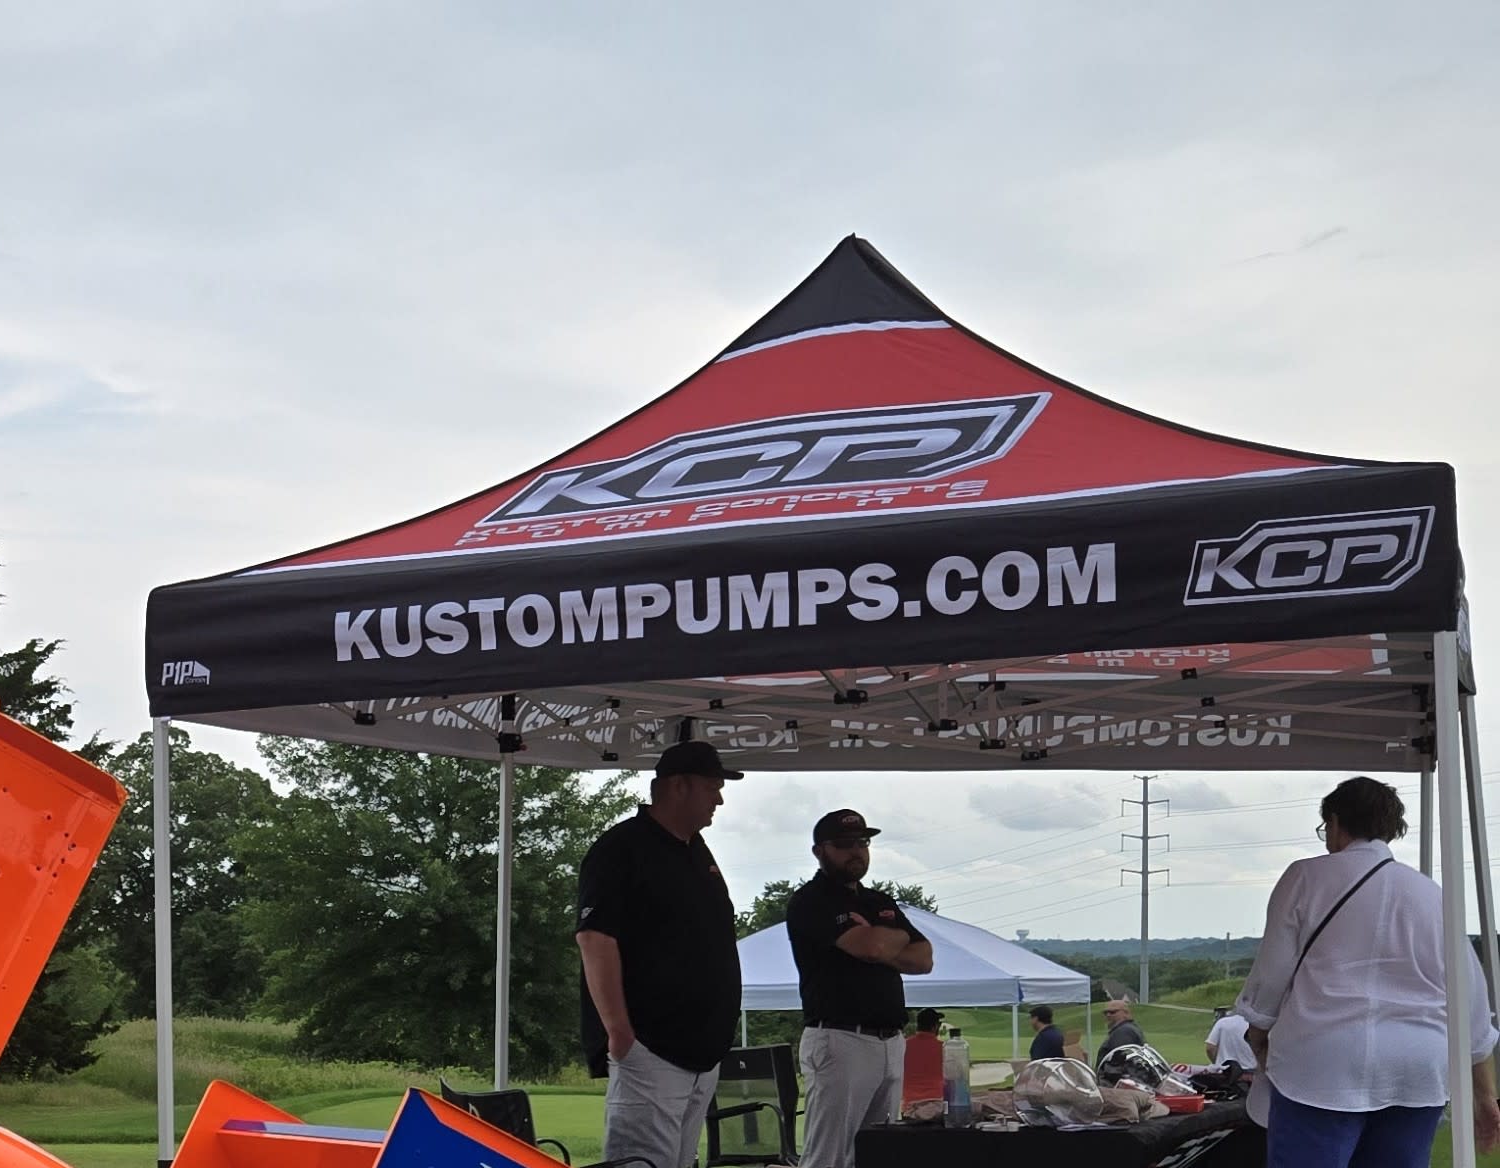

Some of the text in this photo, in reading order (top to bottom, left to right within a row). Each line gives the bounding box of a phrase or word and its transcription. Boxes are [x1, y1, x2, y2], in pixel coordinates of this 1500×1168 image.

[503, 405, 1018, 516] KCP
[464, 480, 988, 537] KUSTOM CONCRETE
[1194, 514, 1422, 594] KCP
[334, 543, 1117, 662] KUSTOMPUMPS.COM
